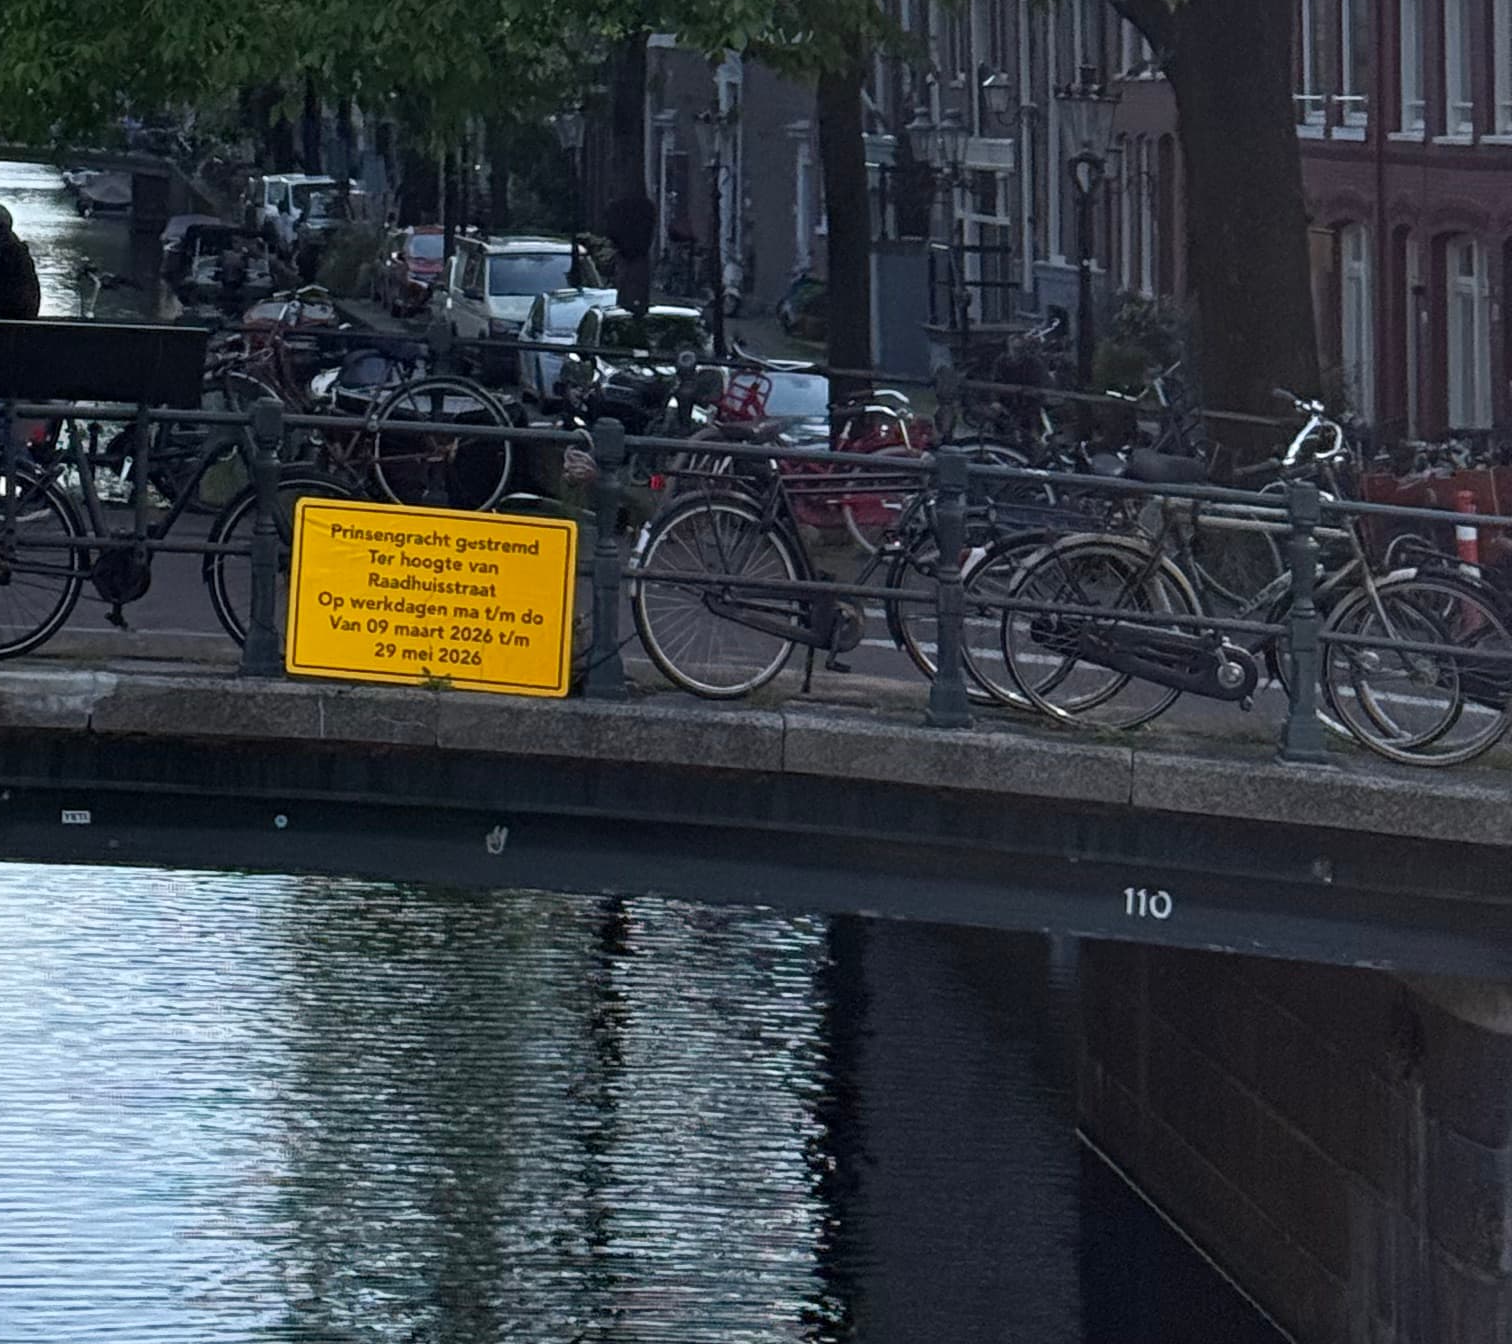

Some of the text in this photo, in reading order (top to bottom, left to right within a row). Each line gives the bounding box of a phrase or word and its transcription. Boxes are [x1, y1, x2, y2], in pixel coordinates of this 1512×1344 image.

[331, 524, 539, 555] Prinsengracht gestremd
[368, 549, 498, 575] Ter hoogte van
[368, 573, 496, 597] Raadhuisstraat
[318, 591, 543, 625] Op werkdagen ma t/m do
[330, 615, 529, 647] Van 09 maart 2026 t/m
[375, 642, 482, 665] 29 mei 2026
[1124, 887, 1172, 919] 110
